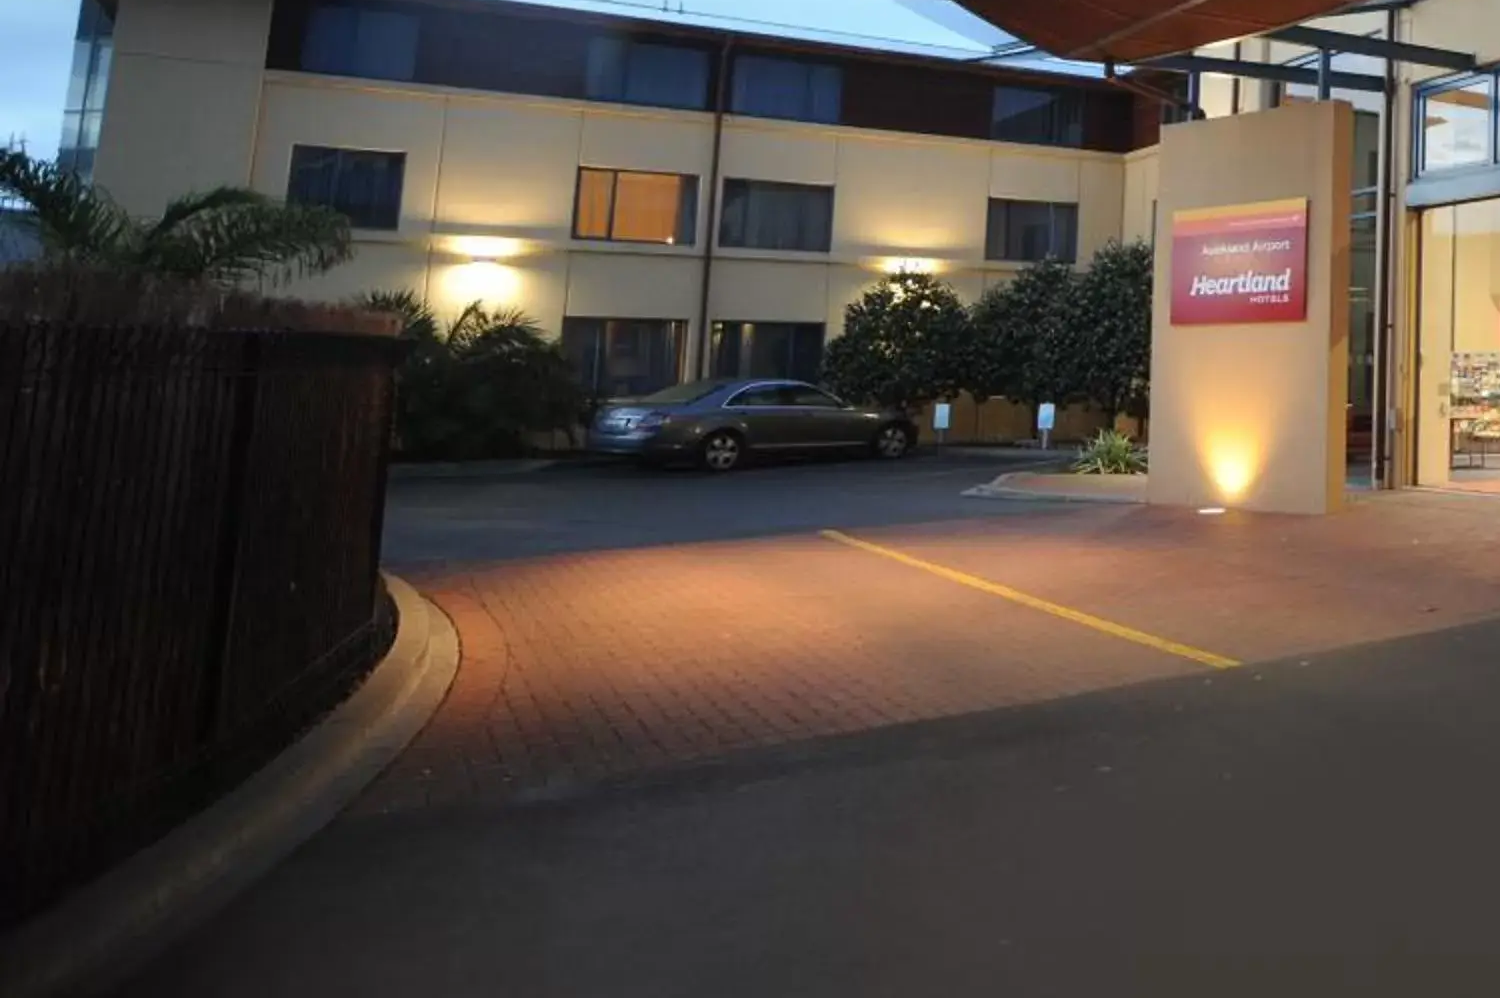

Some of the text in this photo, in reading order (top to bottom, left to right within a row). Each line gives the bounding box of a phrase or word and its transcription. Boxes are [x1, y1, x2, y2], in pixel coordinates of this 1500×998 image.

[1202, 238, 1290, 256] Auckland Airport
[1190, 268, 1291, 296] Heartland
